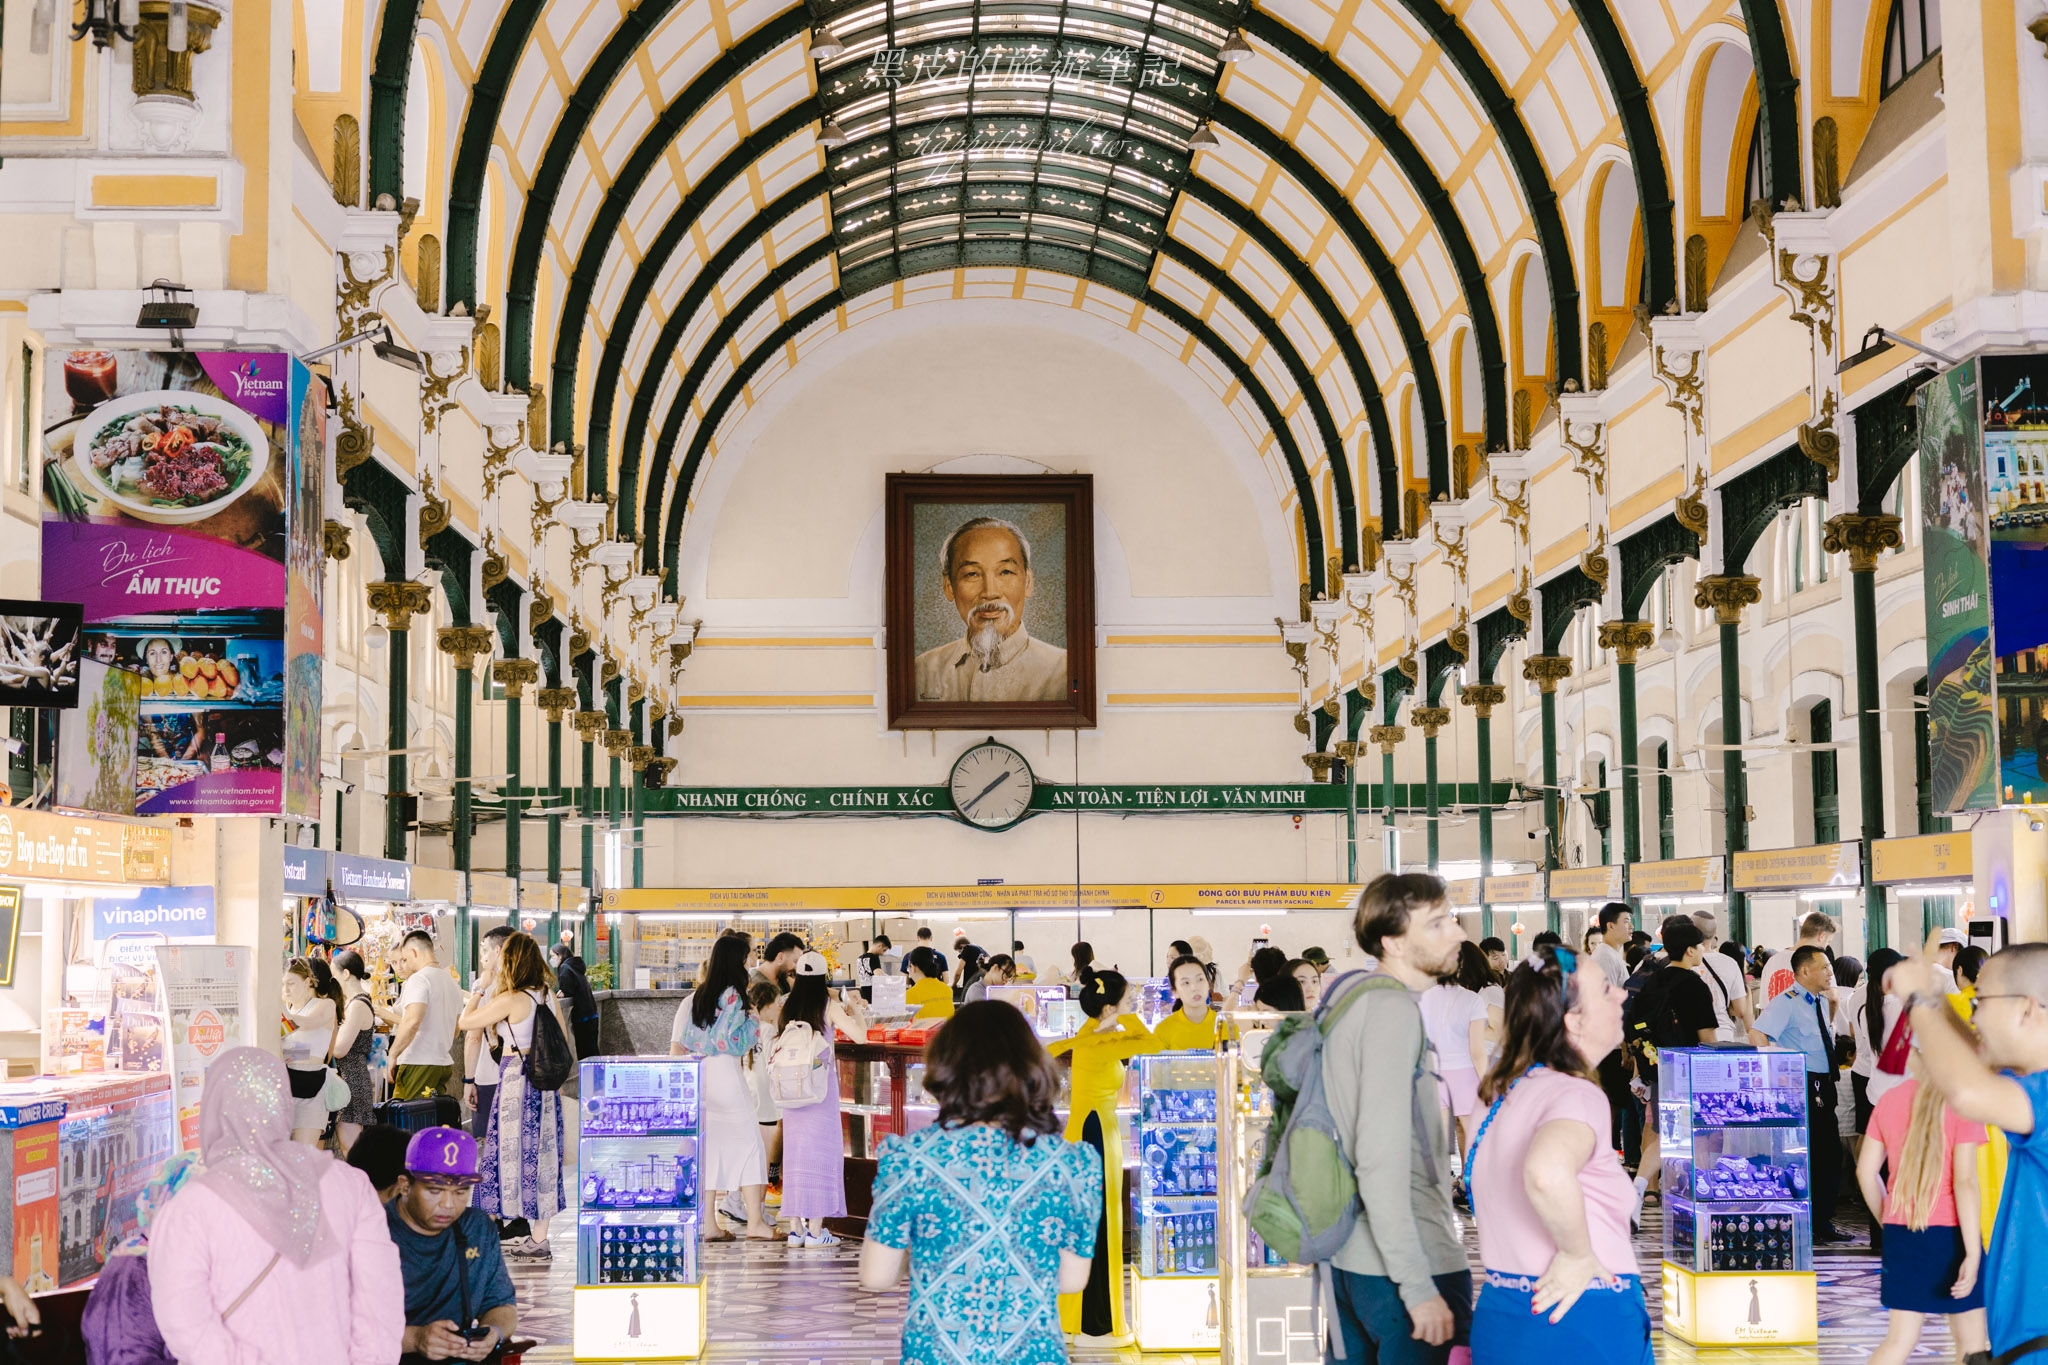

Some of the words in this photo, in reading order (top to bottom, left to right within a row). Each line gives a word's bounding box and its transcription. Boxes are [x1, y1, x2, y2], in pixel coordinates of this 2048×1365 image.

[229, 371, 283, 398] Vietnam
[100, 540, 138, 572] Du
[142, 535, 176, 564] lịch
[125, 569, 160, 595] ẨM
[164, 576, 222, 600] THỰC
[1942, 599, 1960, 618] SINH
[1960, 588, 1978, 613] THÁI
[169, 797, 275, 806] www.vietnamtourism.gov.vn
[200, 786, 275, 795] www.vietnam.travel
[676, 793, 738, 807] NHANH
[744, 789, 806, 807] CHÓNG
[830, 788, 888, 806] CHÍNH
[897, 788, 934, 806] XÁC
[1052, 790, 1074, 805] AN
[1078, 788, 1123, 804] TOÀN
[1136, 787, 1177, 807] TIỆN
[1180, 789, 1209, 807] LỢI
[1222, 787, 1256, 804] VĂN
[1260, 790, 1306, 804] MINH
[17, 831, 34, 872] Hop
[36, 835, 64, 874] on-Hop
[341, 867, 362, 886] Vietnam
[362, 870, 387, 889] Handmade
[387, 872, 406, 890] Souvenir
[1198, 888, 1223, 897] ĐÓNG
[103, 904, 206, 925] vinaphone
[18, 1105, 42, 1124] DINNER
[42, 1102, 66, 1120] CRUISE
